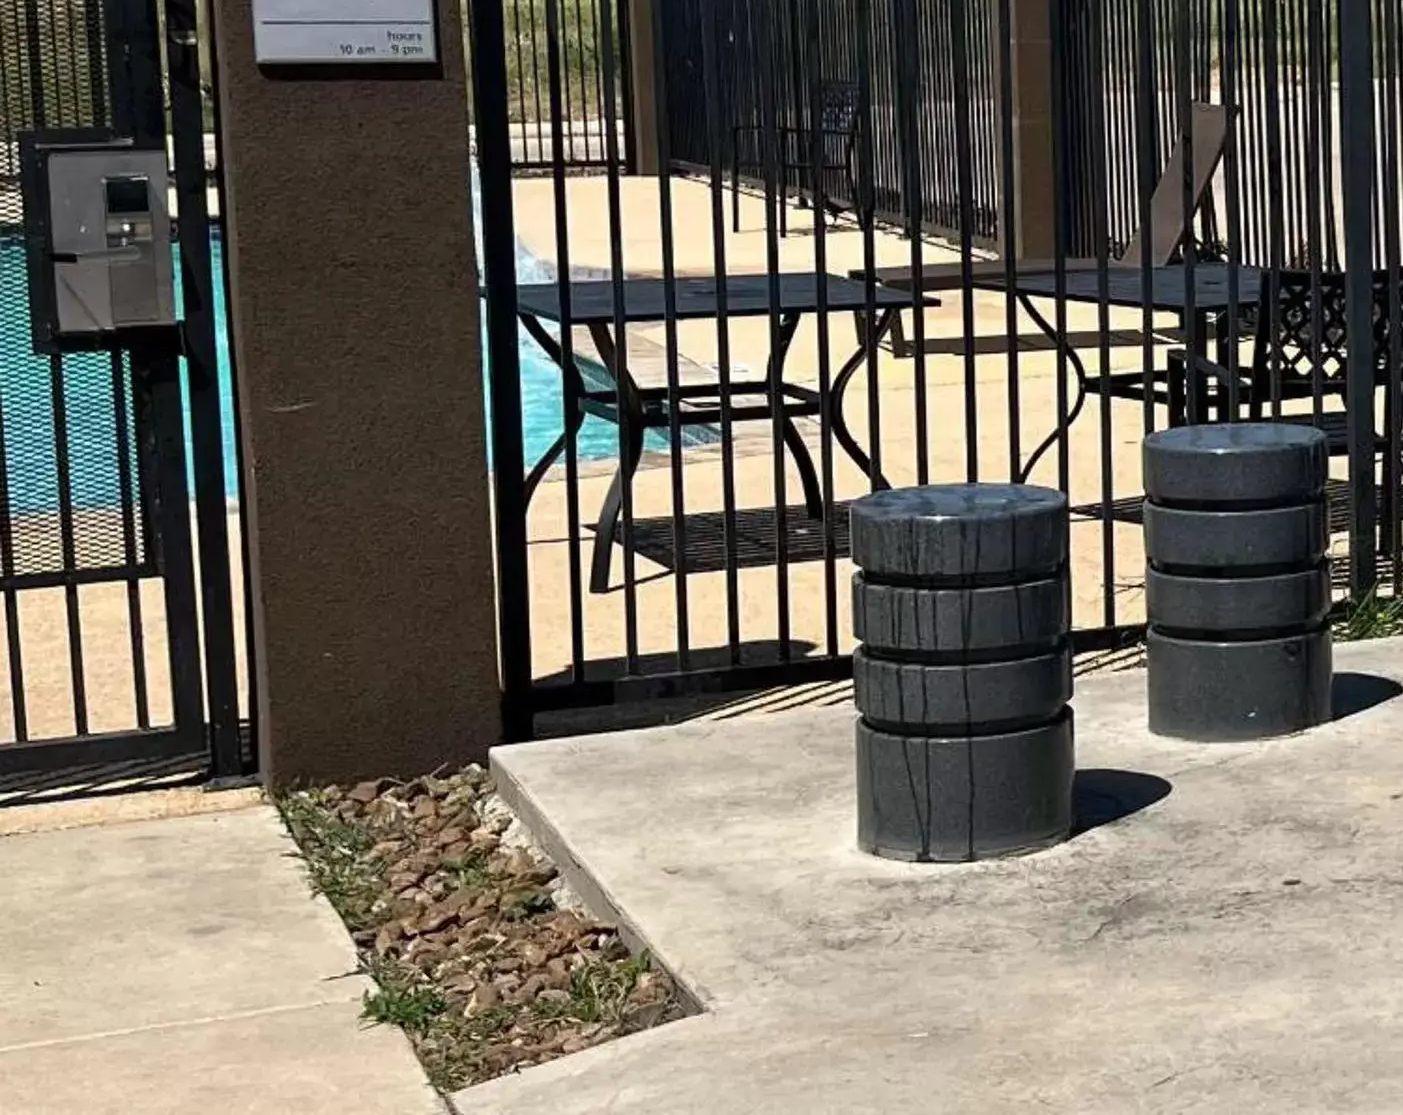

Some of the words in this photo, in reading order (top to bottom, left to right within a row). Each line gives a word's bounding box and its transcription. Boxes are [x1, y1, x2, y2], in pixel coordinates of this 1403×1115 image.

[387, 30, 422, 41] hours
[340, 44, 353, 55] 10
[357, 46, 376, 55] am
[402, 46, 423, 56] pm
